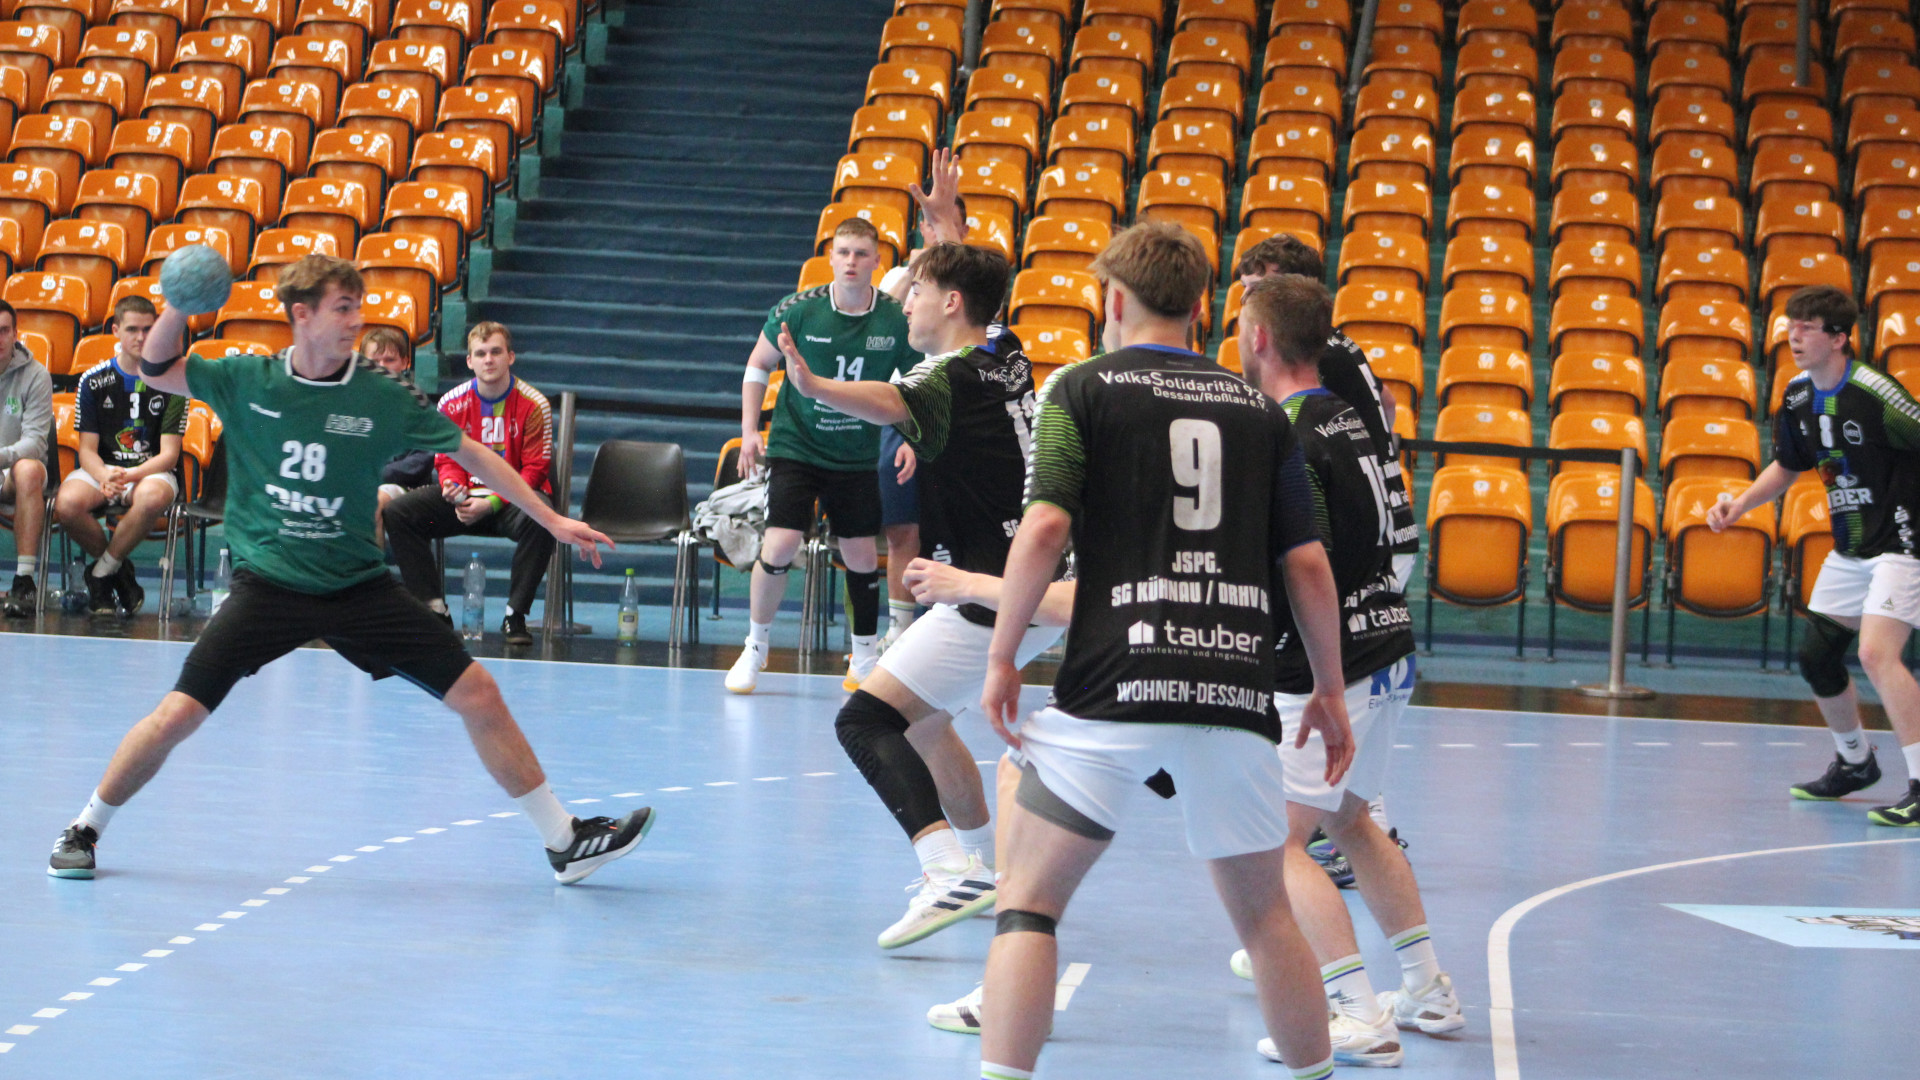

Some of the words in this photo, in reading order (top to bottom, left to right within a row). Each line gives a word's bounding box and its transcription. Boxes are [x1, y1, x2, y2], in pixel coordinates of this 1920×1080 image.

[833, 355, 864, 382] 14
[1098, 370, 1241, 394] VolksSolidarität
[1243, 384, 1265, 401] 92
[1153, 387, 1247, 406] Dessau/Roßlau
[130, 392, 140, 419] 3
[481, 416, 505, 443] 20
[280, 440, 327, 482] 28
[1169, 418, 1221, 531] 9
[1827, 488, 1873, 508] IBER
[1172, 551, 1222, 573] JSPG.
[1112, 583, 1132, 607] SG
[1136, 575, 1201, 603] KÜHNAU
[1218, 582, 1259, 609] DRHV
[1164, 620, 1262, 653] tauber
[1129, 647, 1189, 655] Architekten
[1116, 680, 1270, 715] WOHNEN-DESSAU.DE
